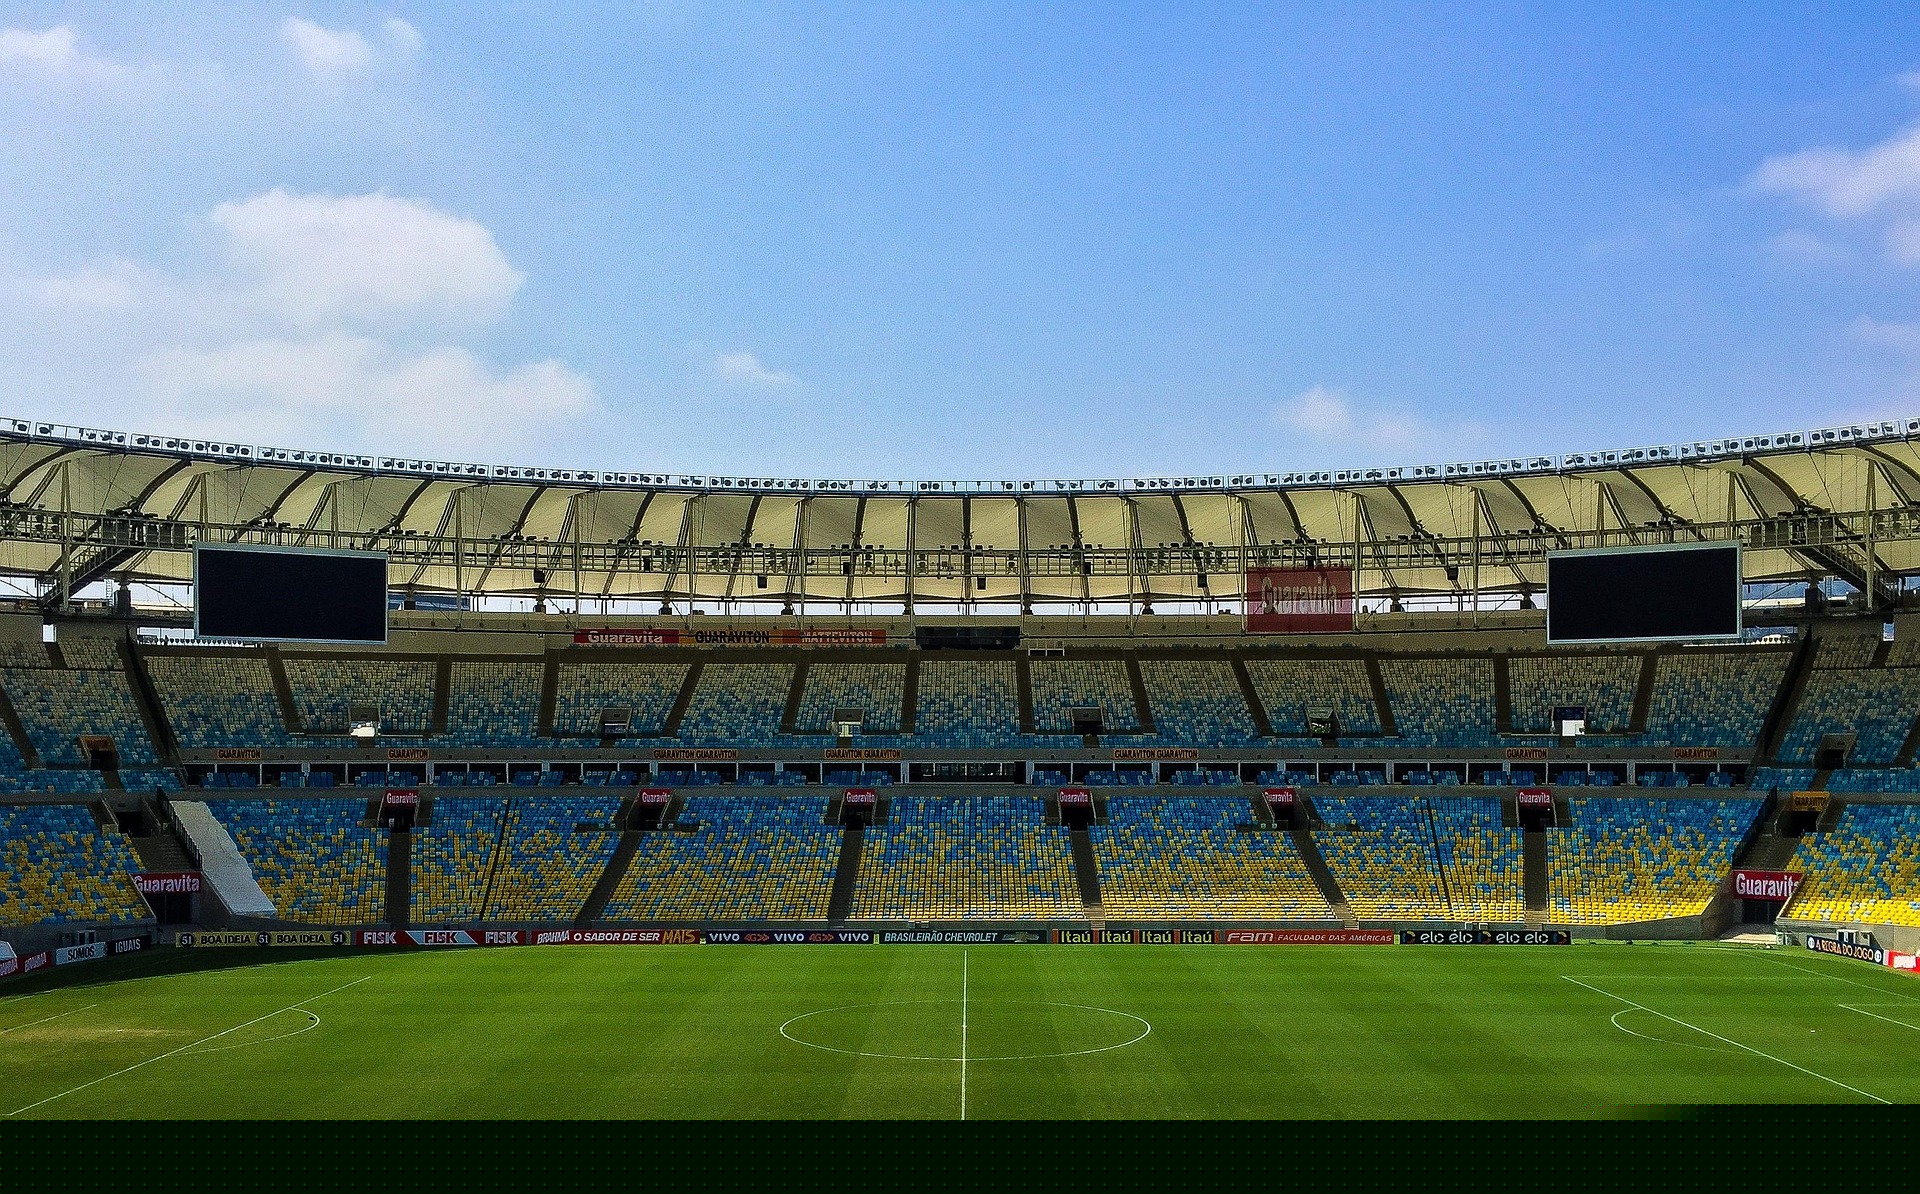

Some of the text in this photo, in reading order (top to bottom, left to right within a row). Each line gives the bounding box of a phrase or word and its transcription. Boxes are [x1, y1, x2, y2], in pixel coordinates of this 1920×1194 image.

[1261, 576, 1338, 614] Guaravita
[588, 631, 663, 643] Guaravita
[695, 631, 770, 643] GUARAVITON
[1114, 749, 1198, 758] GUARAVITON GUARAVITON
[386, 792, 418, 804] Guaravita
[1060, 791, 1089, 803] Guaravita
[1519, 792, 1551, 803] Guaravita
[181, 933, 344, 945] 51 BOA IDEIA 51 BOA IDEIA 51
[363, 931, 519, 944] FISK FISK FISK
[537, 929, 696, 945] BRAHMA O SABOR DE SER MAIS
[884, 930, 998, 942] BRASILEIRÃO CHEVROLET
[1061, 930, 1212, 943] Itaú Itaú Itaú Itaú
[1277, 934, 1326, 942] FACULDADE
[1328, 934, 1346, 942] DAS
[1348, 933, 1392, 942] AMÉRICAS
[115, 938, 141, 954] IGUAIS
[1821, 940, 1842, 954] REGRA
[1853, 946, 1874, 961] JOGO
[67, 946, 95, 961] SOMOS
